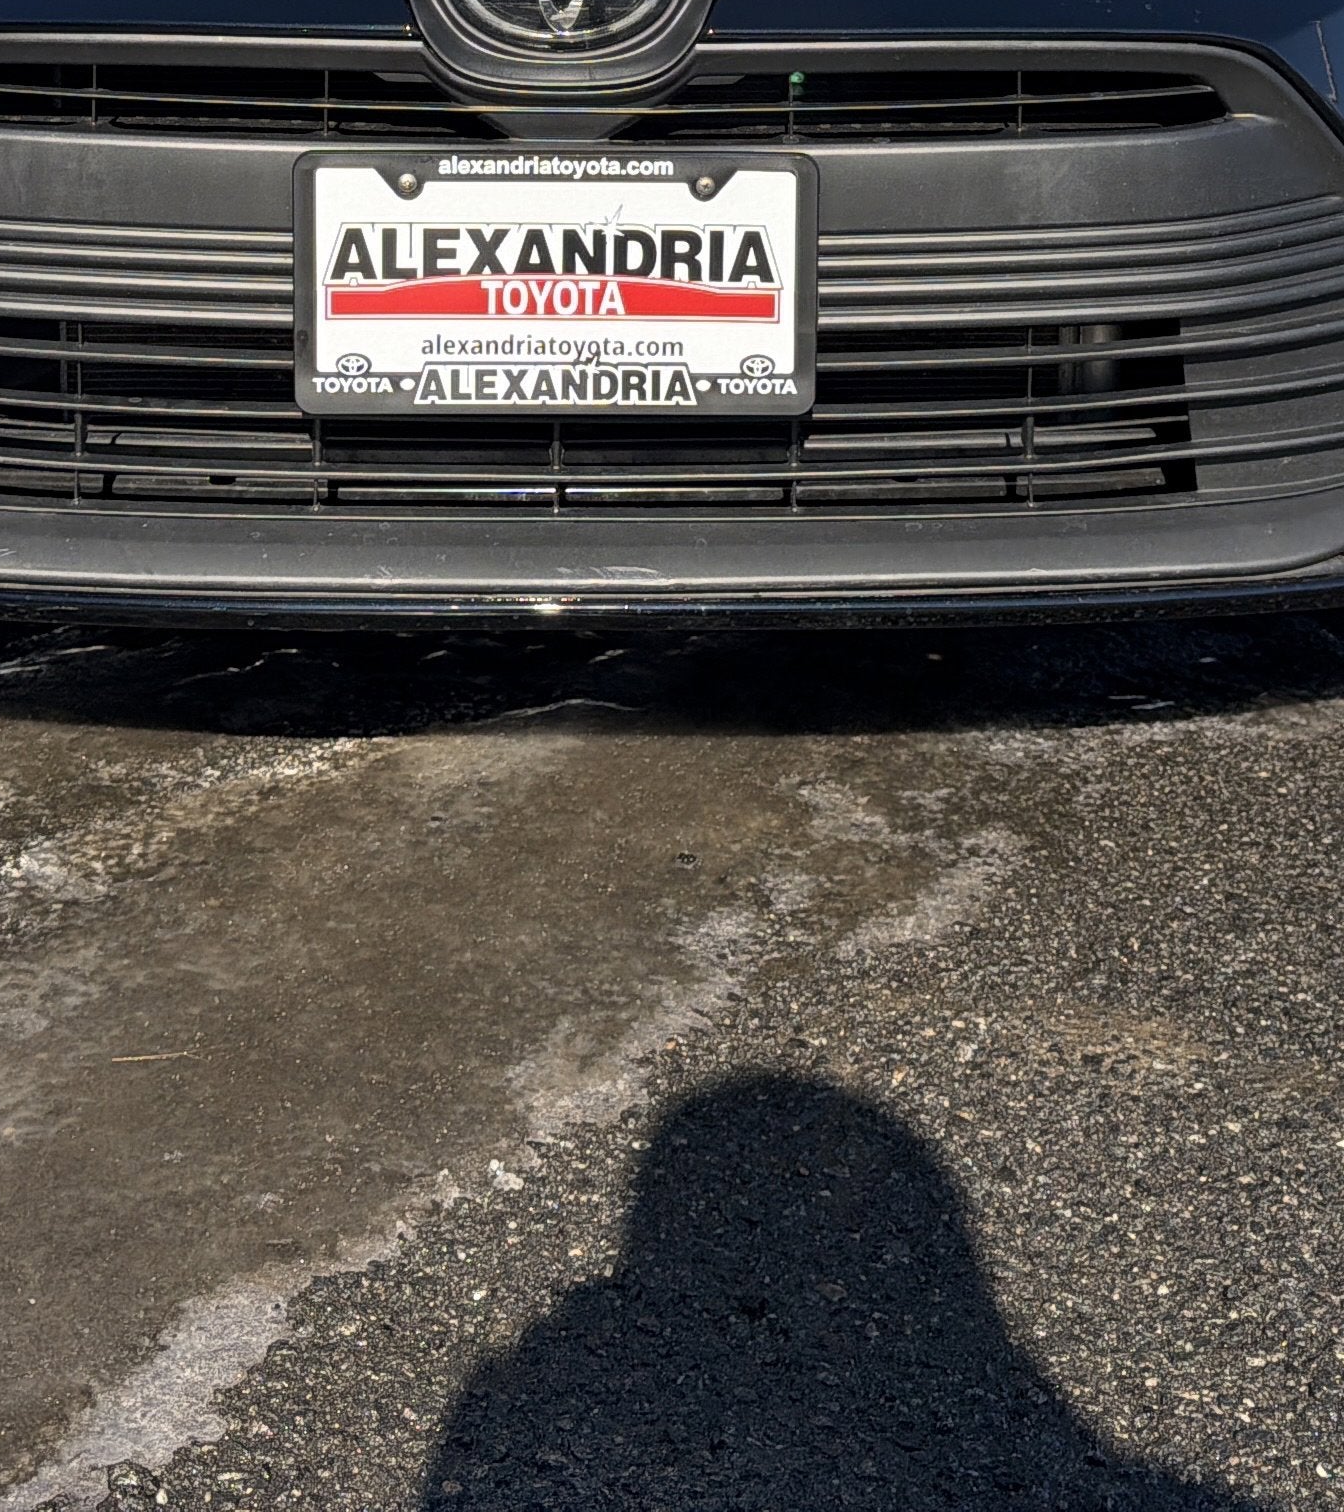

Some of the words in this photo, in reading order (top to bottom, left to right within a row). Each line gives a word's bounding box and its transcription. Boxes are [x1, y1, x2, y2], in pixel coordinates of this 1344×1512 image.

[438, 156, 674, 179] alexandriatoyota.com
[328, 226, 777, 285] ALEXANDRIA
[480, 280, 626, 316] TOYOTA
[421, 334, 684, 359] alexandriatoyota.com
[312, 377, 394, 394] TOYOTA
[416, 366, 695, 404] ALEXANDRIA
[717, 378, 798, 395] TOYOTA
